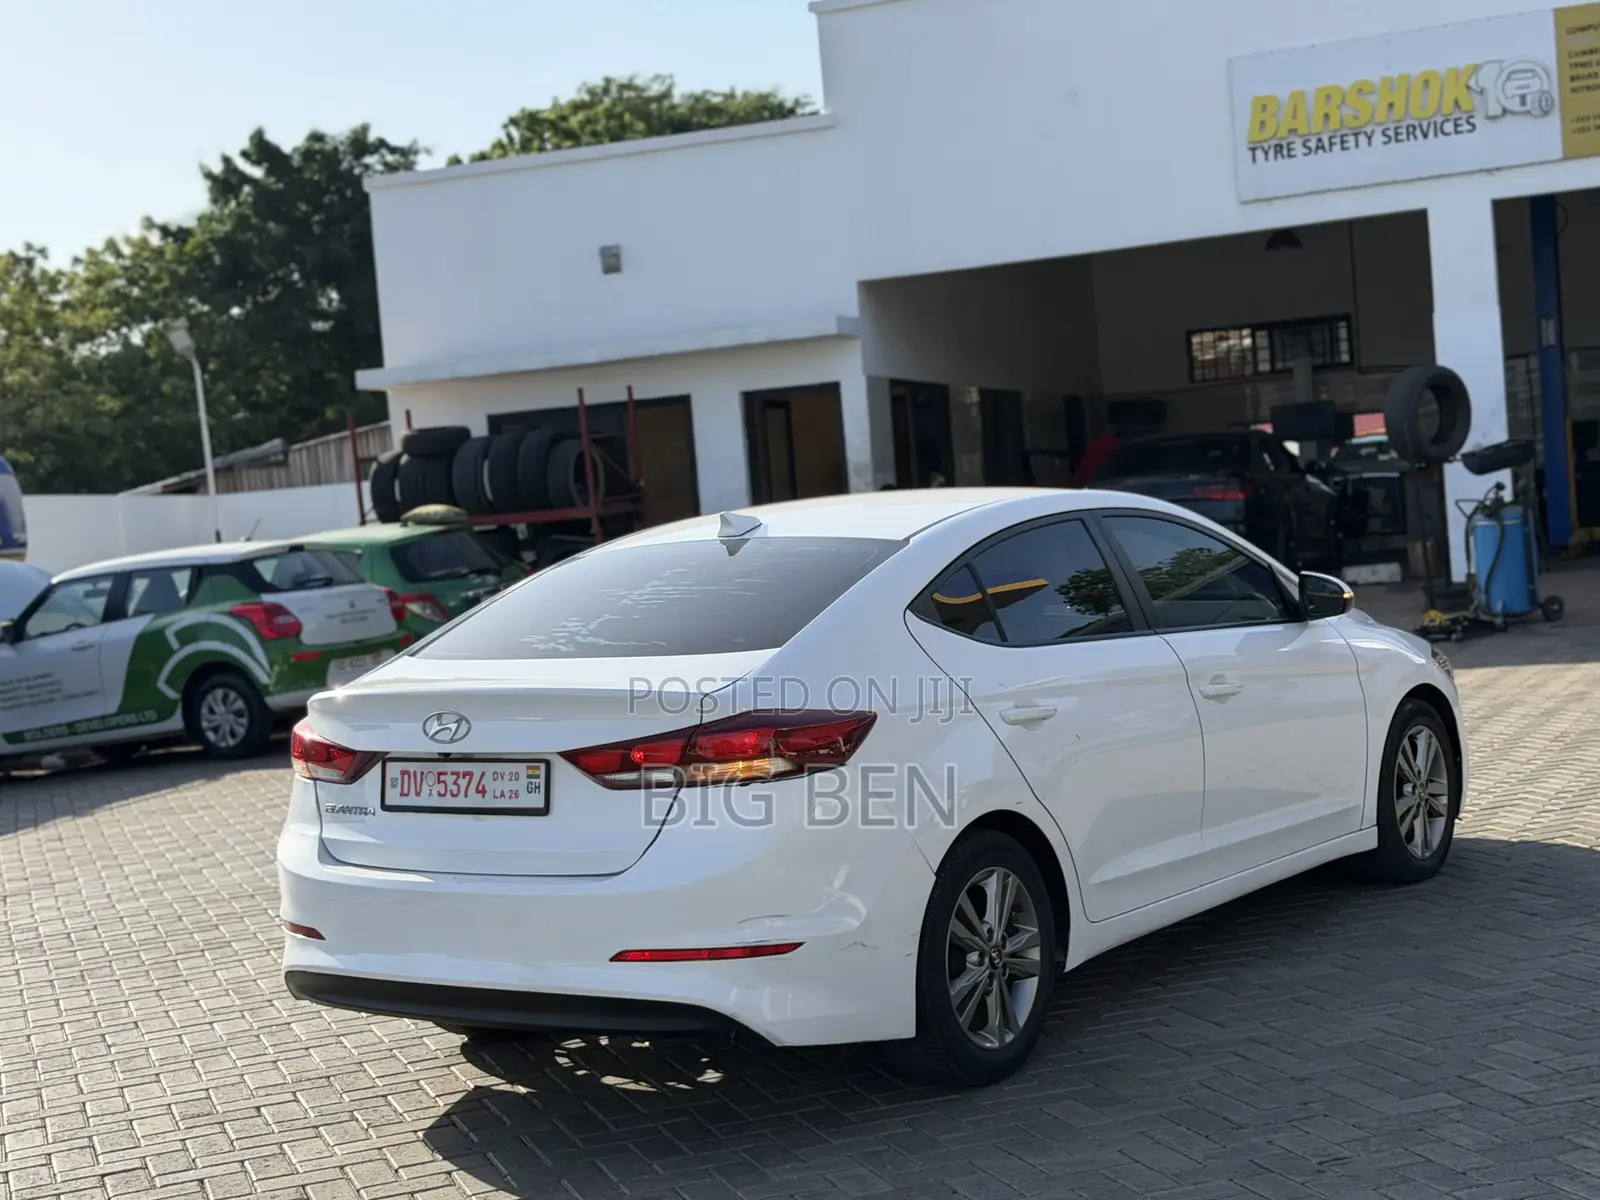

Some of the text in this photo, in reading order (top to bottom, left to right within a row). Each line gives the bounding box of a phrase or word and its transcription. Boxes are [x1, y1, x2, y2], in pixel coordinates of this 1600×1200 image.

[1246, 63, 1478, 144] BARSHOK
[1247, 115, 1478, 165] TYRE SAFETY SERVICES
[399, 769, 425, 798] DV
[437, 770, 488, 799] 5374
[492, 770, 520, 782] DV 20
[493, 788, 520, 800] LA 26
[526, 781, 541, 795] GH
